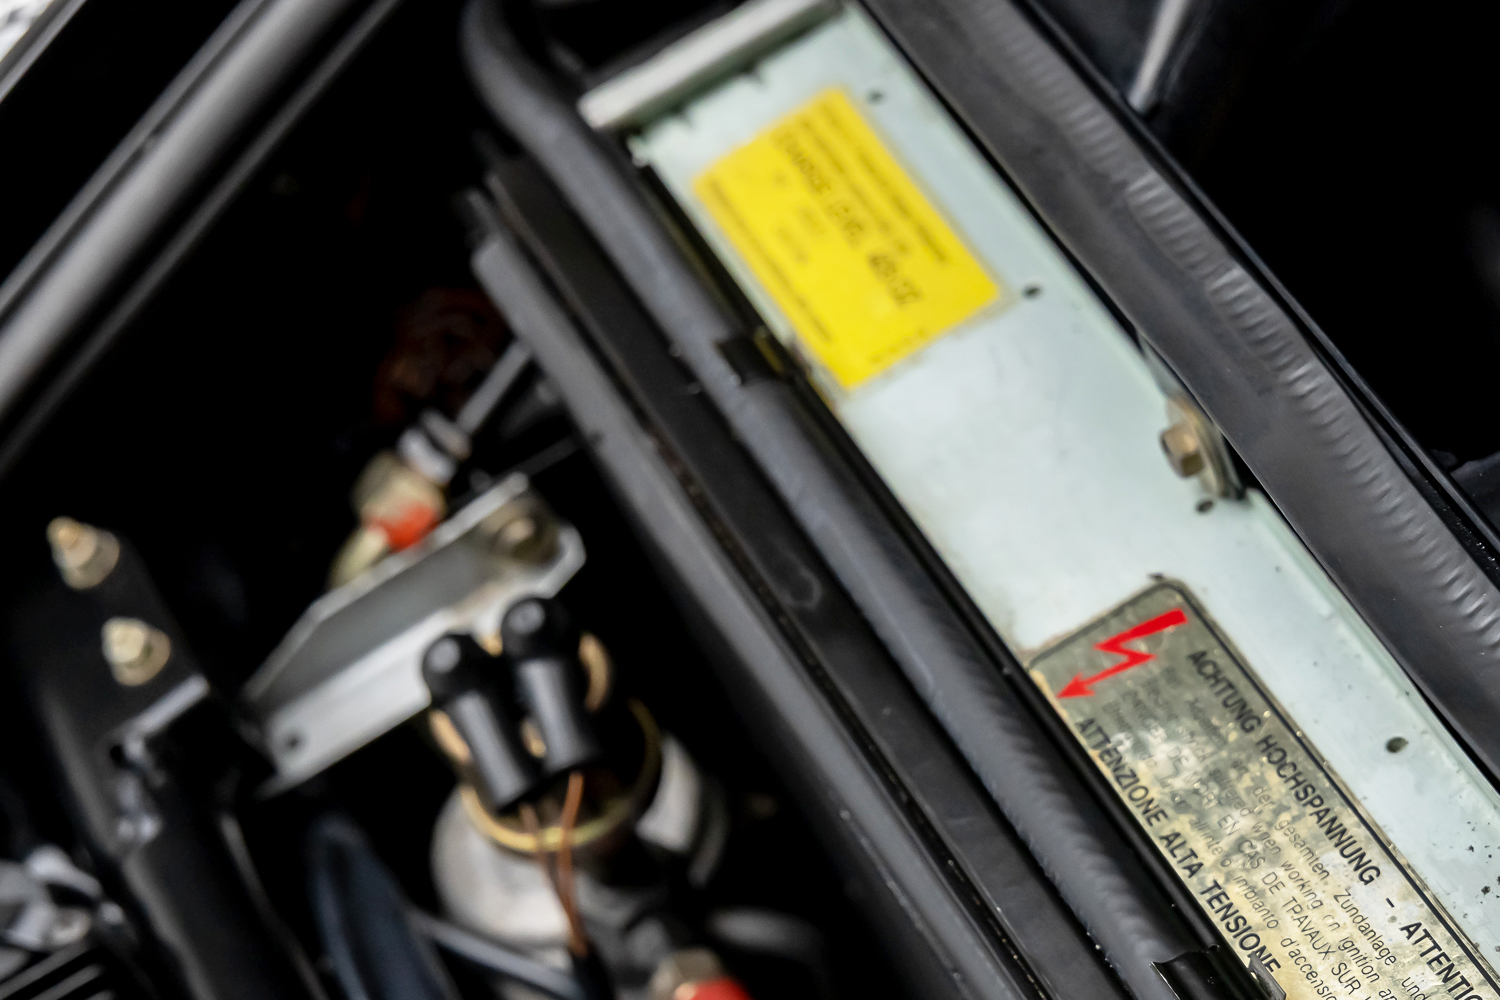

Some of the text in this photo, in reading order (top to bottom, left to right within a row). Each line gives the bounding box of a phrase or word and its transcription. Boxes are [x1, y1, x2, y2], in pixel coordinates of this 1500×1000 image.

[1070, 715, 1172, 831] ATTENZIONE
[1157, 828, 1207, 879] ALTA
[1185, 647, 1265, 737] ACHTUNG
[1252, 733, 1384, 887] HOCHSPANNUNG
[1250, 784, 1277, 811] der
[1273, 818, 1332, 884] gesamten
[1216, 814, 1241, 838] EN
[1234, 839, 1267, 871] CAS
[1260, 872, 1286, 896] DE
[1279, 897, 1337, 962] TRAVAUX
[1328, 961, 1363, 996] SUR
[1230, 874, 1282, 932] impianto
[1250, 820, 1285, 857] when
[1275, 859, 1327, 914] working
[1336, 934, 1384, 985] ignition
